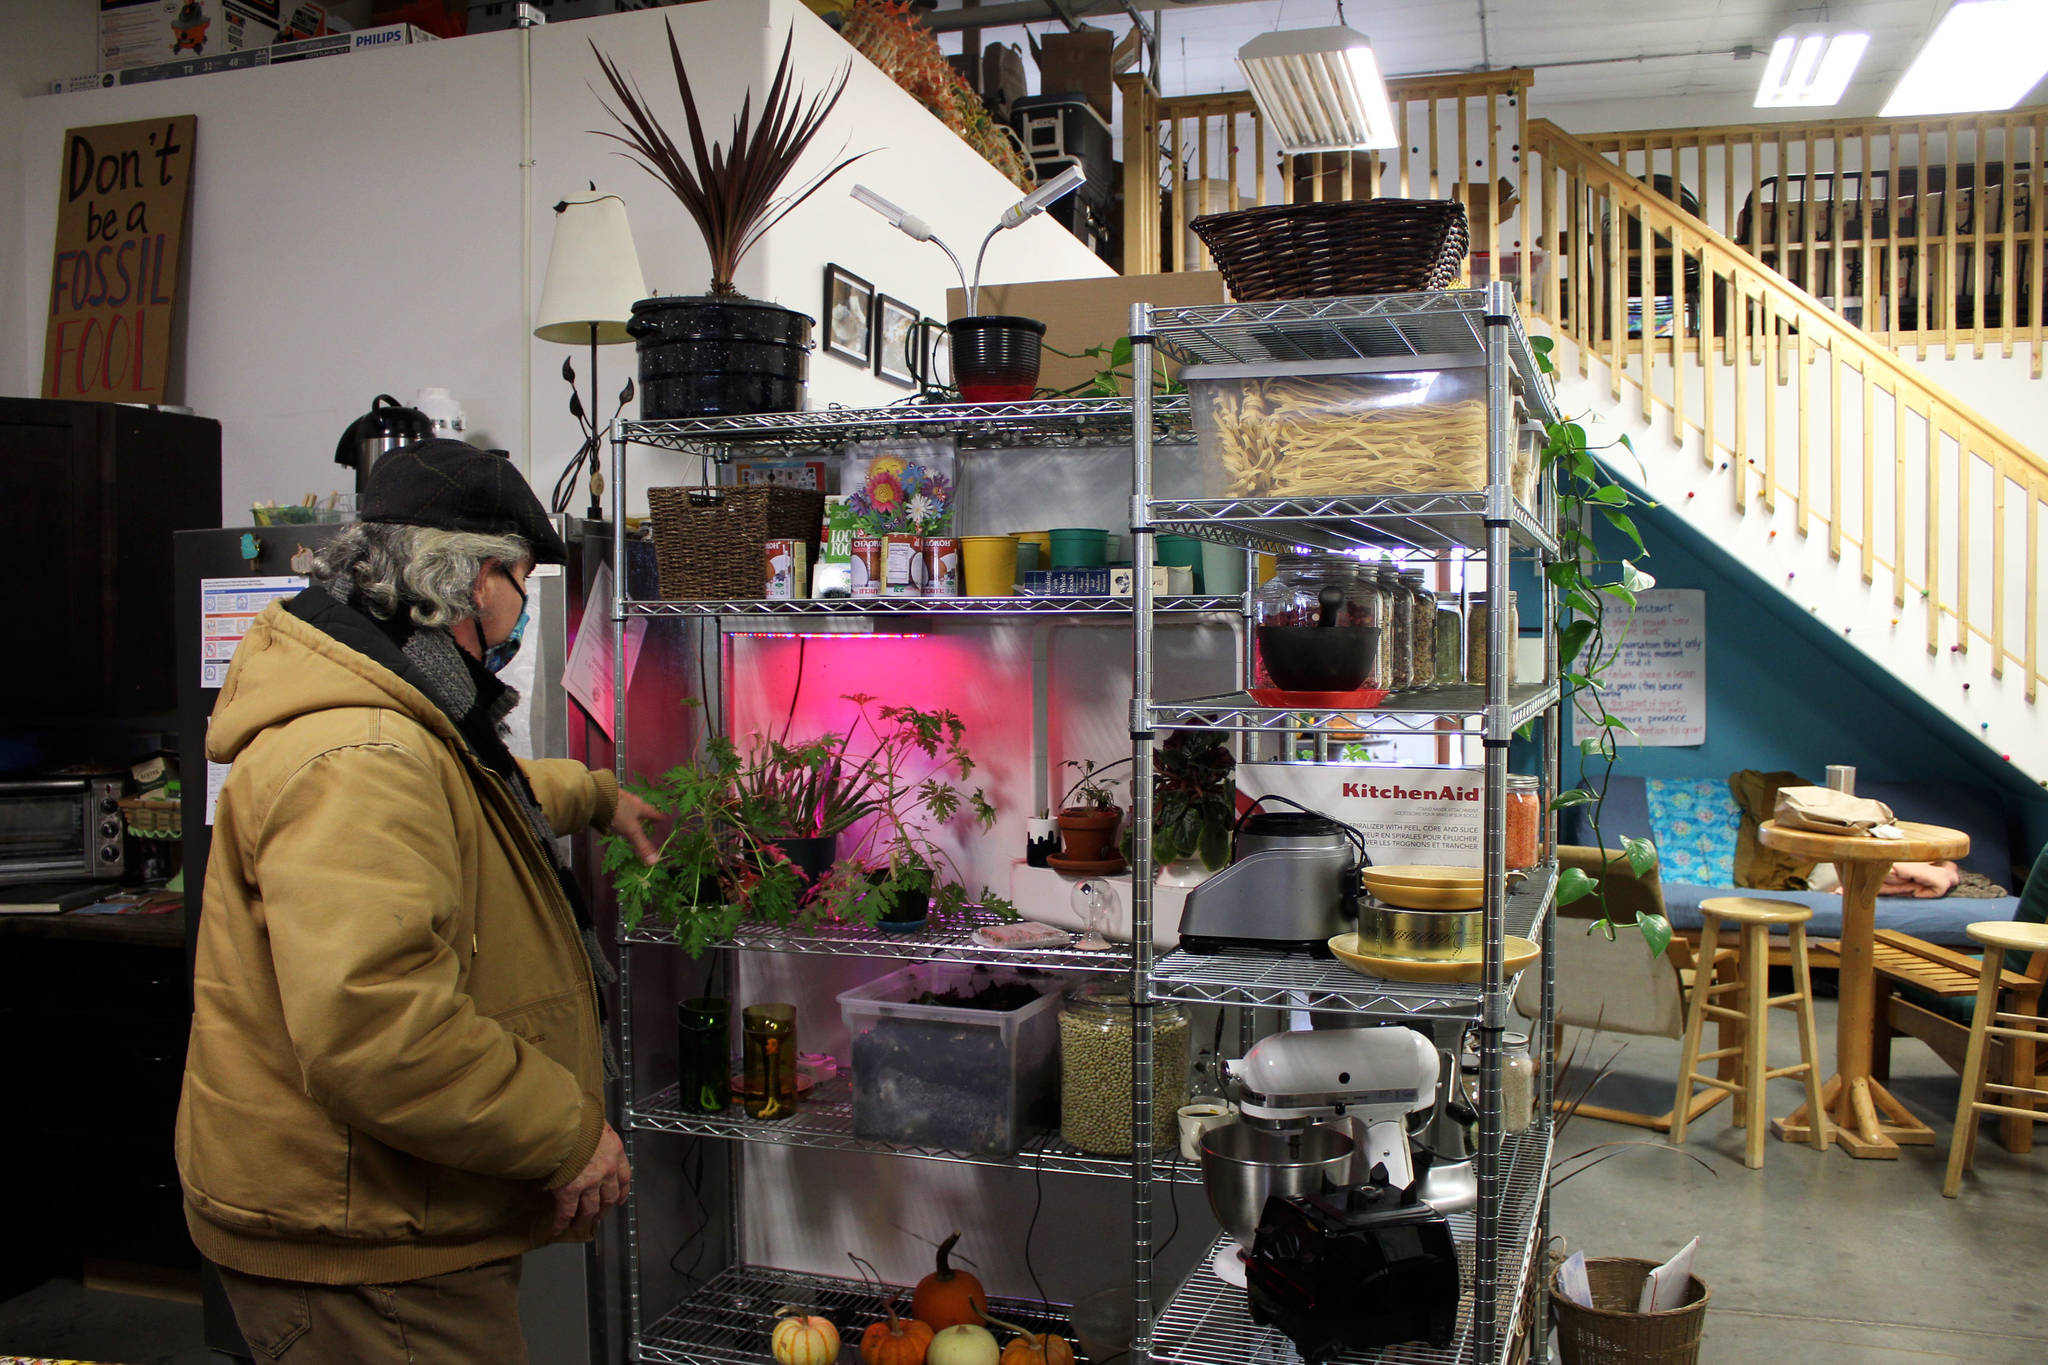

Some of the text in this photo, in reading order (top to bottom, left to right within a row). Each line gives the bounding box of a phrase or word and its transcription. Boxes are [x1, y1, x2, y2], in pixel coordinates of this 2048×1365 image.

[356, 30, 401, 47] PHILIPS
[69, 124, 181, 202] Don't
[88, 201, 148, 243] be a
[52, 233, 170, 315] FOSSIL
[51, 309, 156, 398] FOOL
[831, 529, 859, 543] LOCA
[831, 542, 851, 556] FOO
[853, 540, 881, 548] CHAOK
[1044, 571, 1052, 596] Healing
[1648, 714, 1688, 724] presence
[1342, 783, 1479, 801] KitchenAid
[1392, 832, 1421, 840] SPIRALES
[1460, 826, 1478, 834] SLICE
[1392, 840, 1430, 848] TROGNONS
[1442, 842, 1479, 850] TRANCHER
